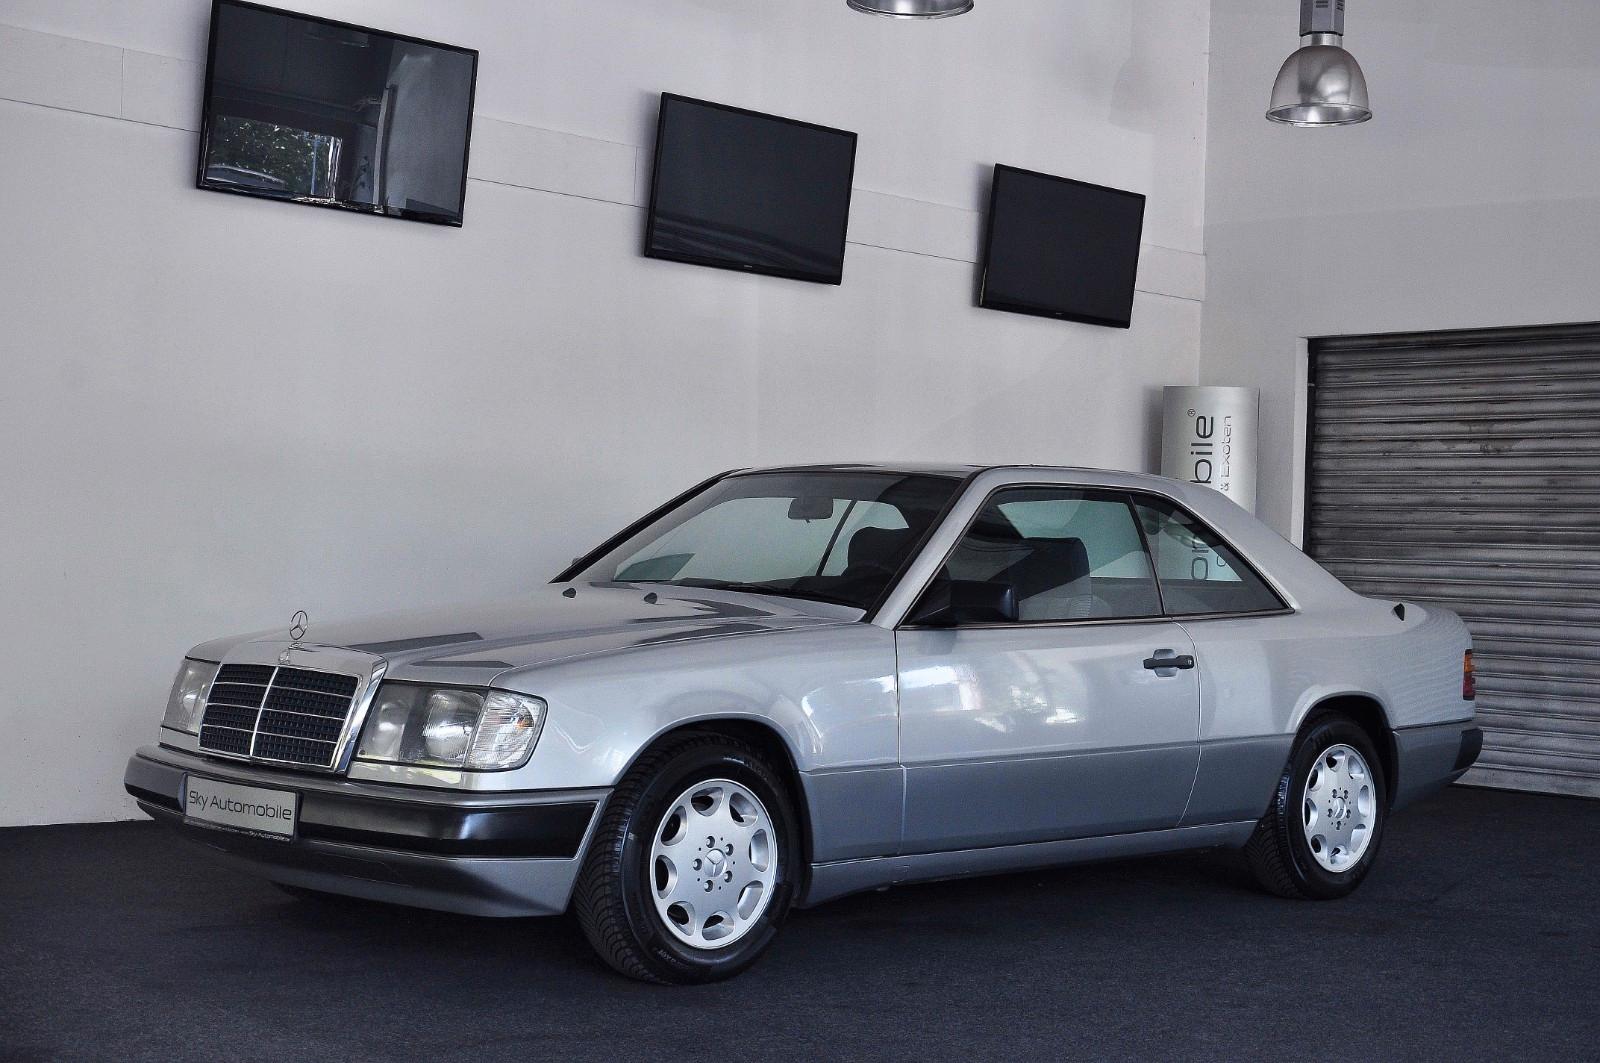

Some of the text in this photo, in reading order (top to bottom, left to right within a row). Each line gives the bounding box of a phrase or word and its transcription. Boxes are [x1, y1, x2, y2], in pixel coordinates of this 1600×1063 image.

[1189, 415, 1214, 484] bile
[1219, 415, 1232, 478] Exoten
[189, 790, 292, 821] Sky Automobile
